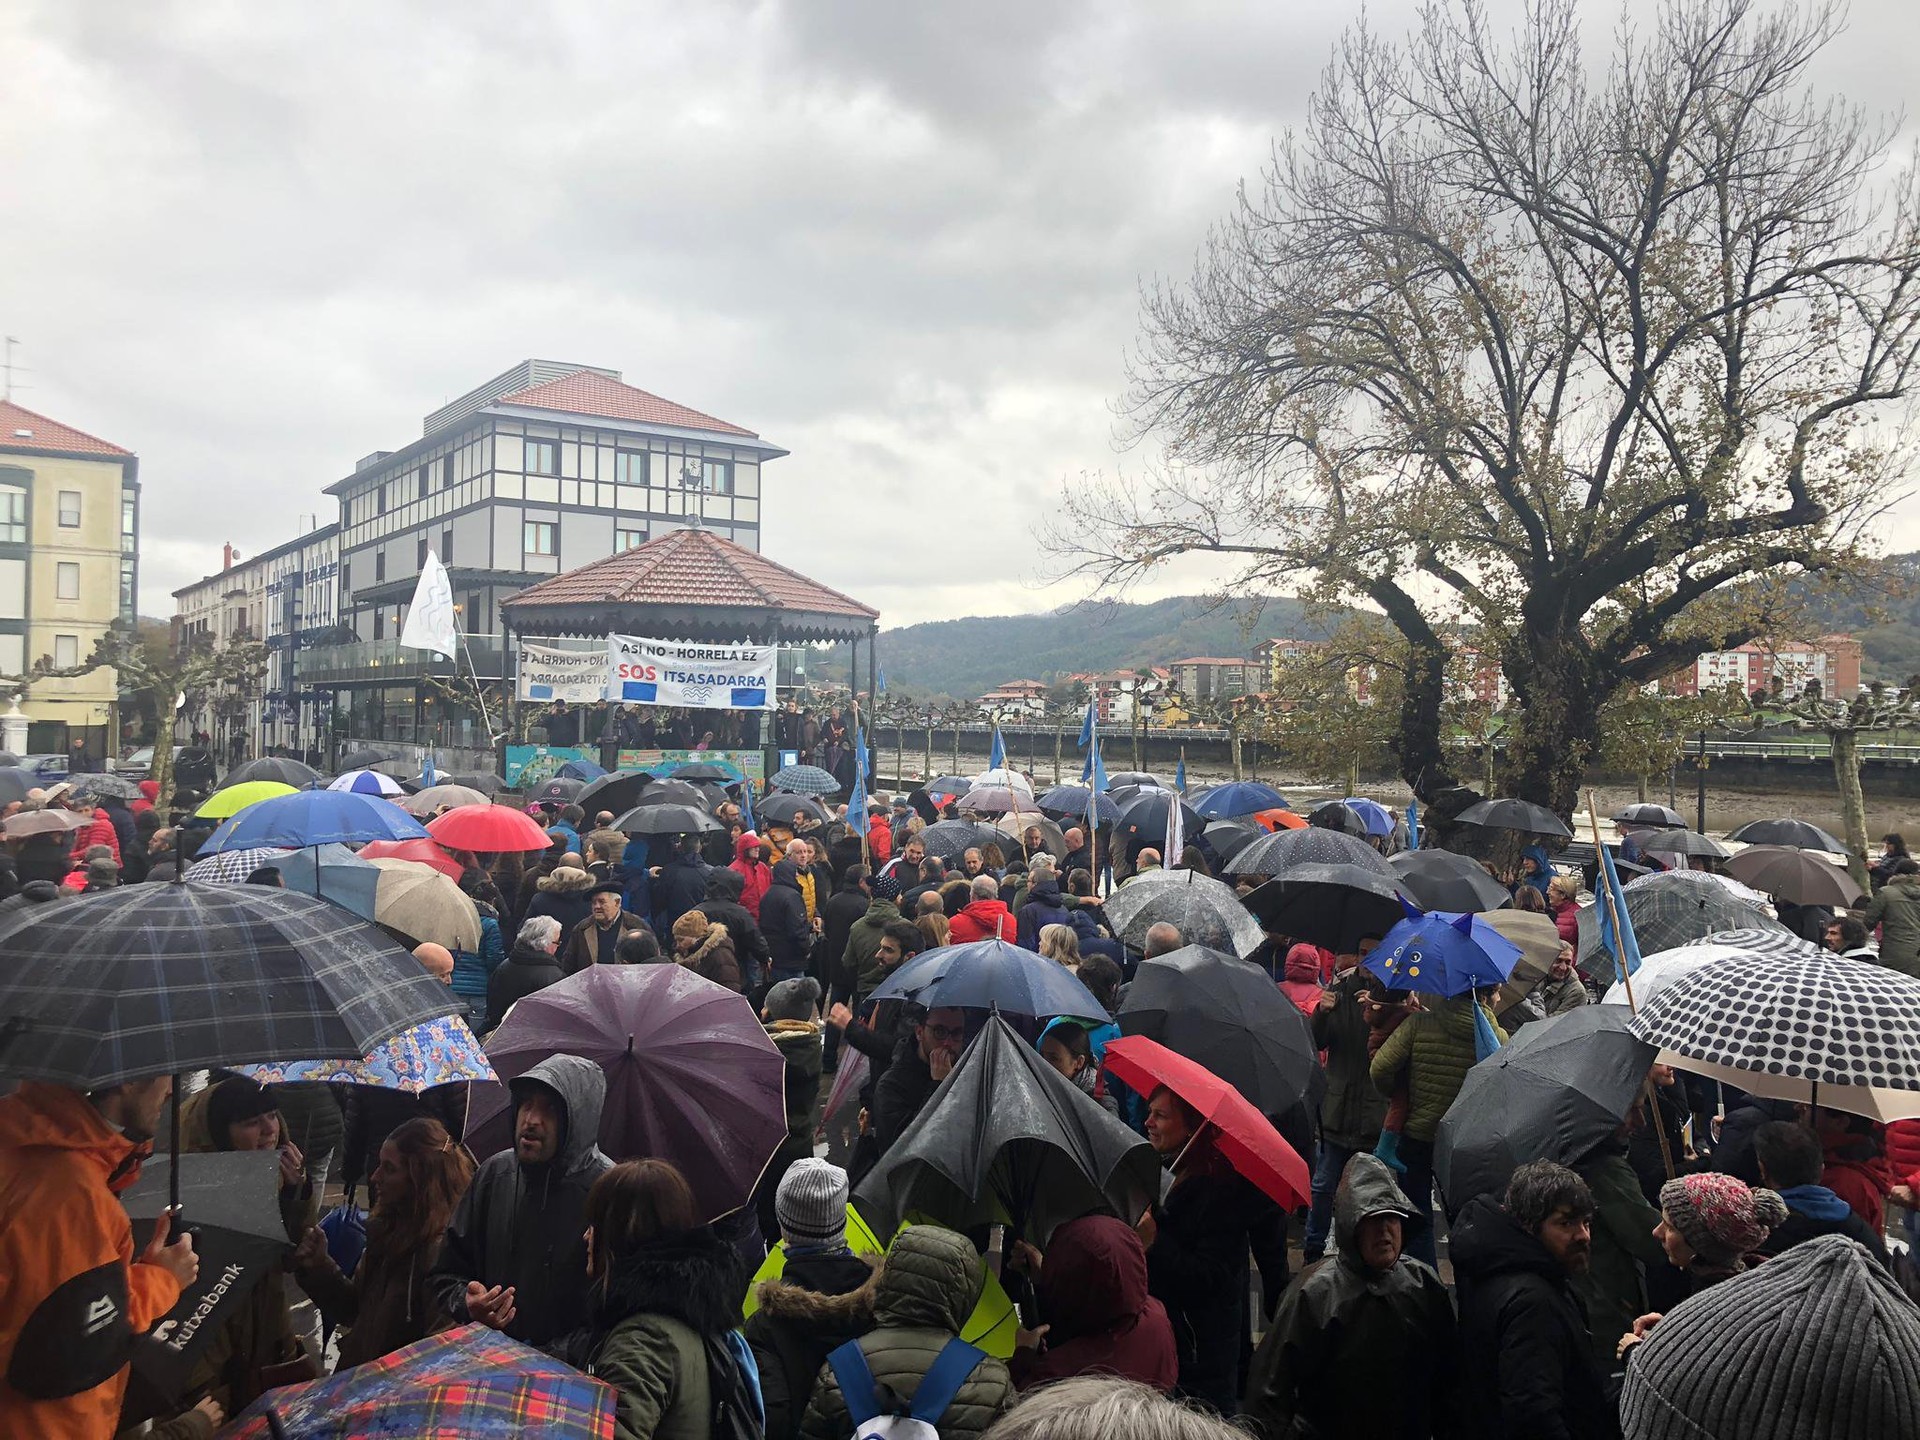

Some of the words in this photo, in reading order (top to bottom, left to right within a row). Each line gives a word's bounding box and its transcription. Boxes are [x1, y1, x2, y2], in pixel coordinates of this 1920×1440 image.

[621, 643, 642, 655] ASÍ
[646, 646, 666, 656] NO
[677, 648, 739, 661] HORRELA
[741, 651, 757, 661] EZ
[618, 663, 657, 681] SOS
[664, 671, 766, 687] ITSASADARRA
[167, 1263, 245, 1351] kutxabank
